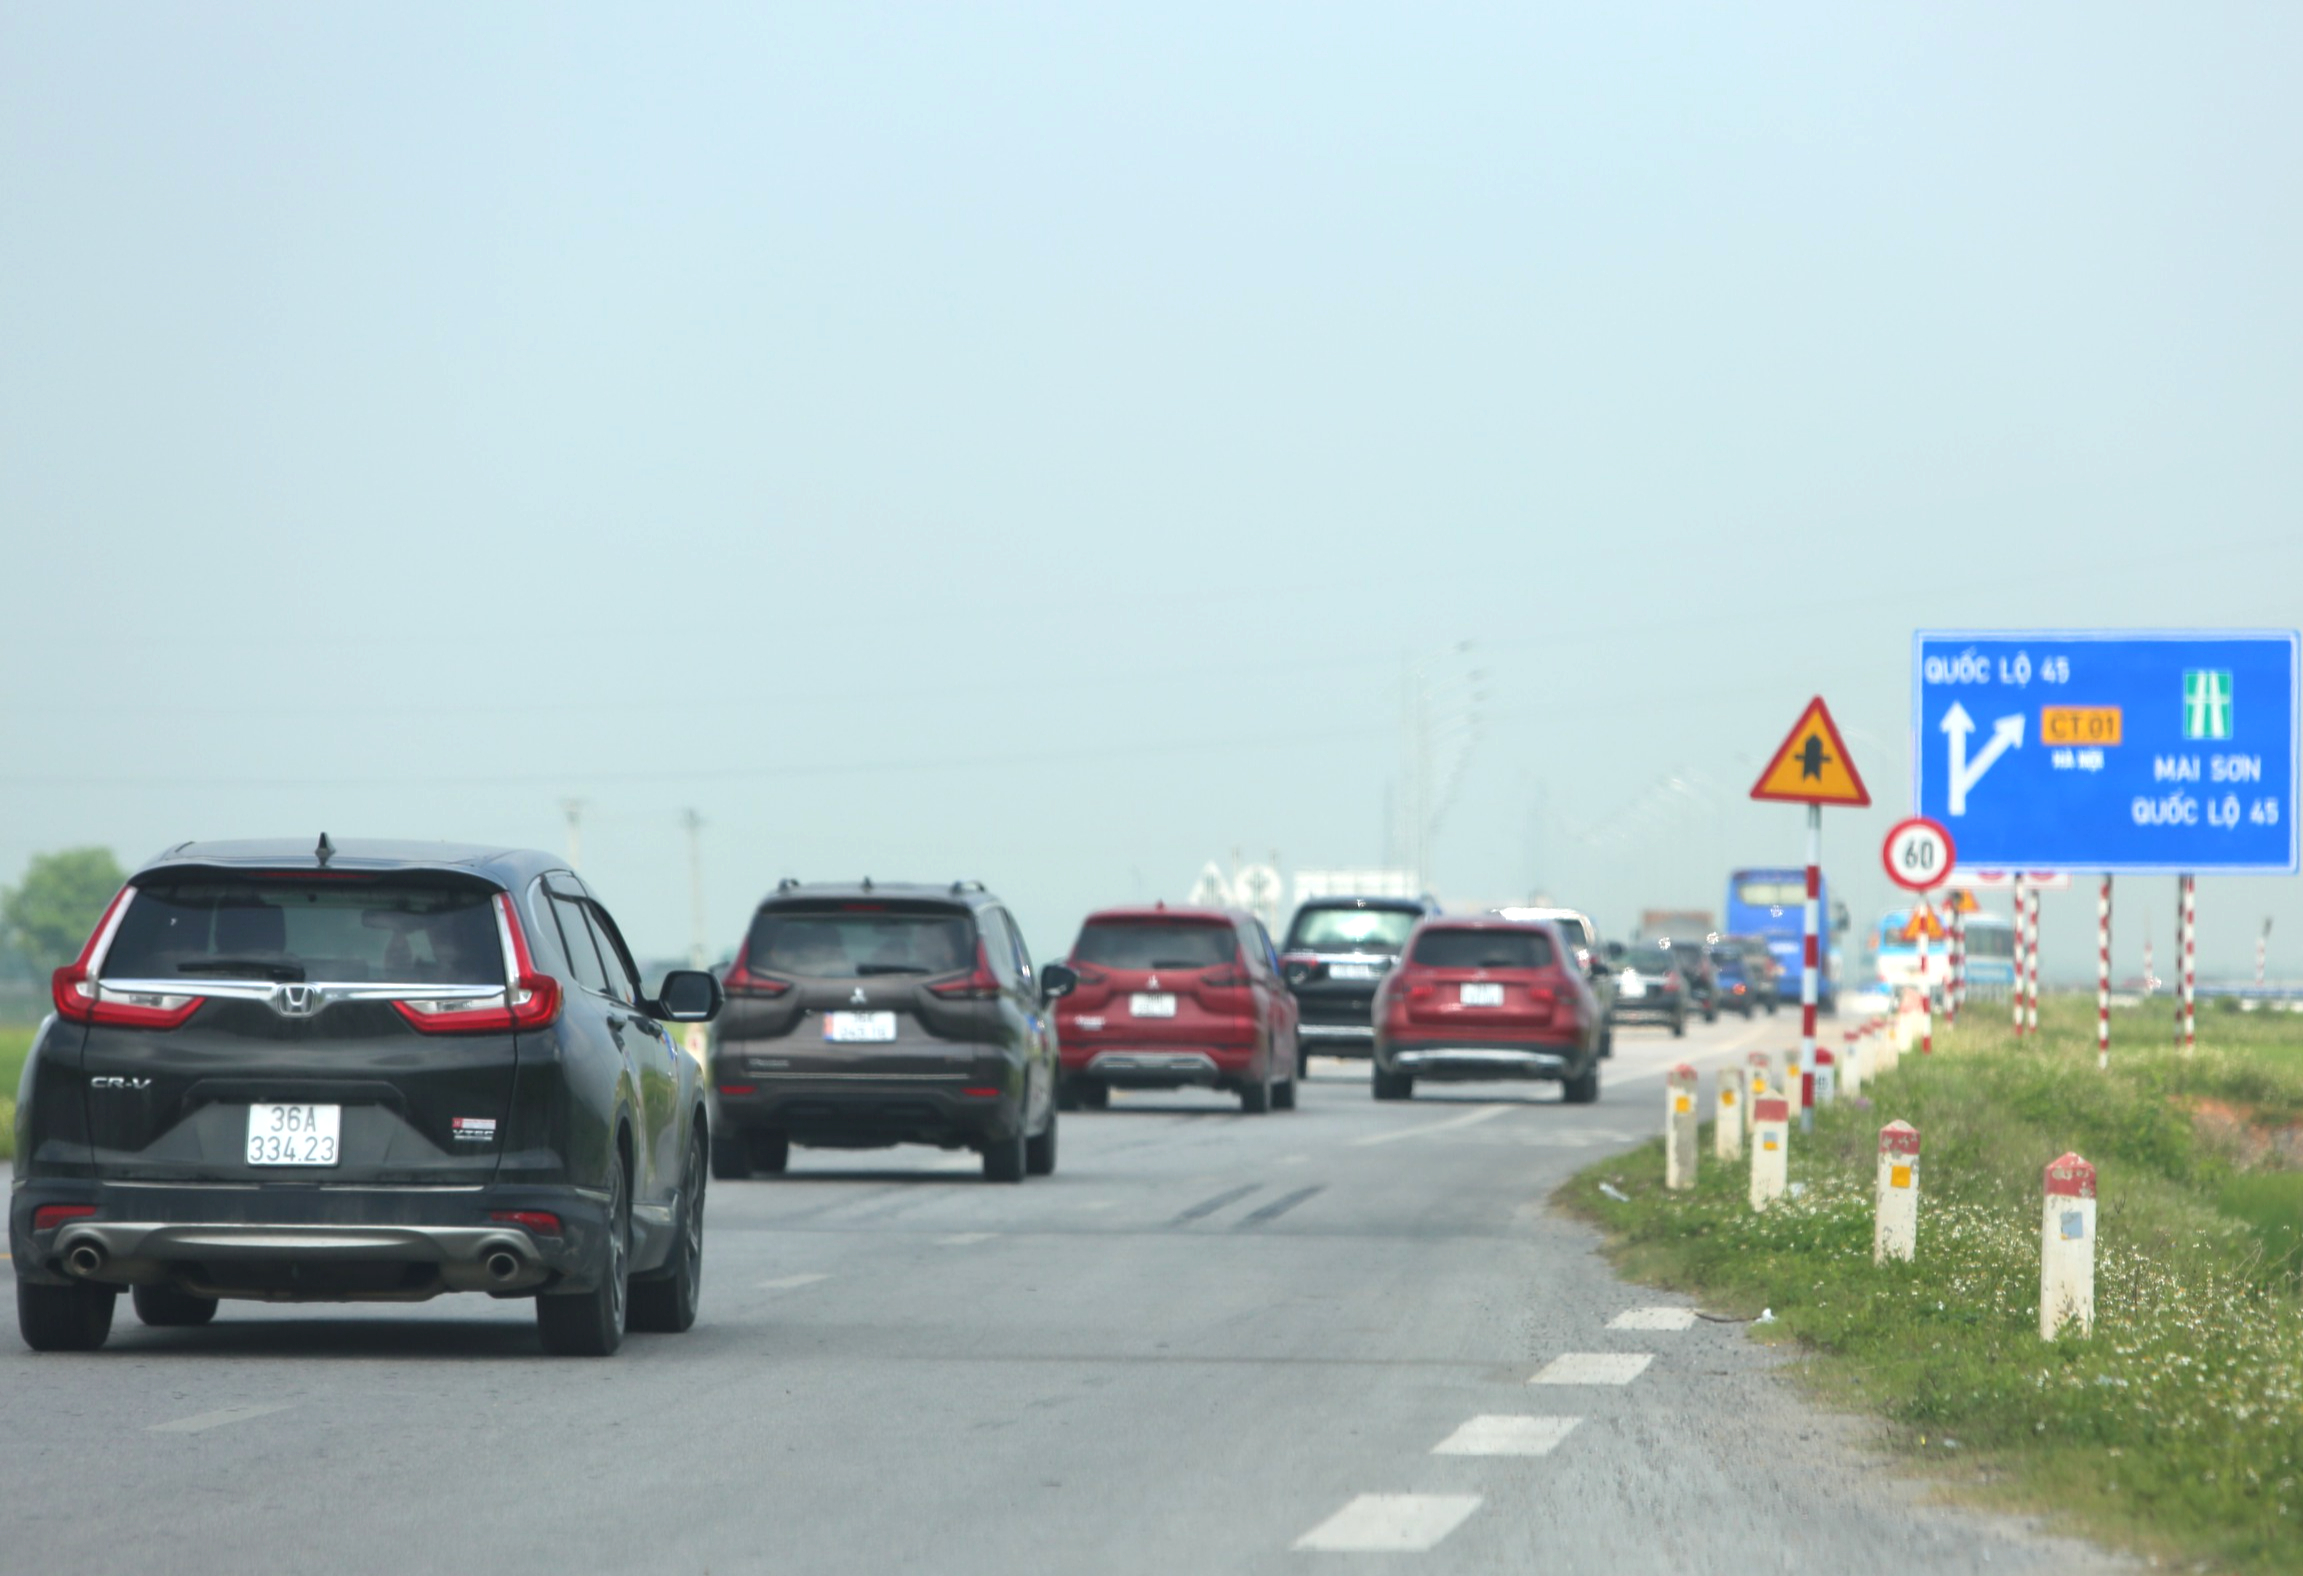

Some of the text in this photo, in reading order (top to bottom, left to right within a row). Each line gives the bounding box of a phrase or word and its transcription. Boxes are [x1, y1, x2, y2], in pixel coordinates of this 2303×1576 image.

[1925, 647, 2070, 689] QUỐC LỘ 45
[2155, 754, 2200, 782] MAI
[2132, 788, 2279, 830] QUỐC LỘ 45
[1905, 839, 1933, 869] 60
[91, 1076, 151, 1089] CR-V
[271, 1106, 316, 1132] 36A
[250, 1136, 335, 1161] 334.23
